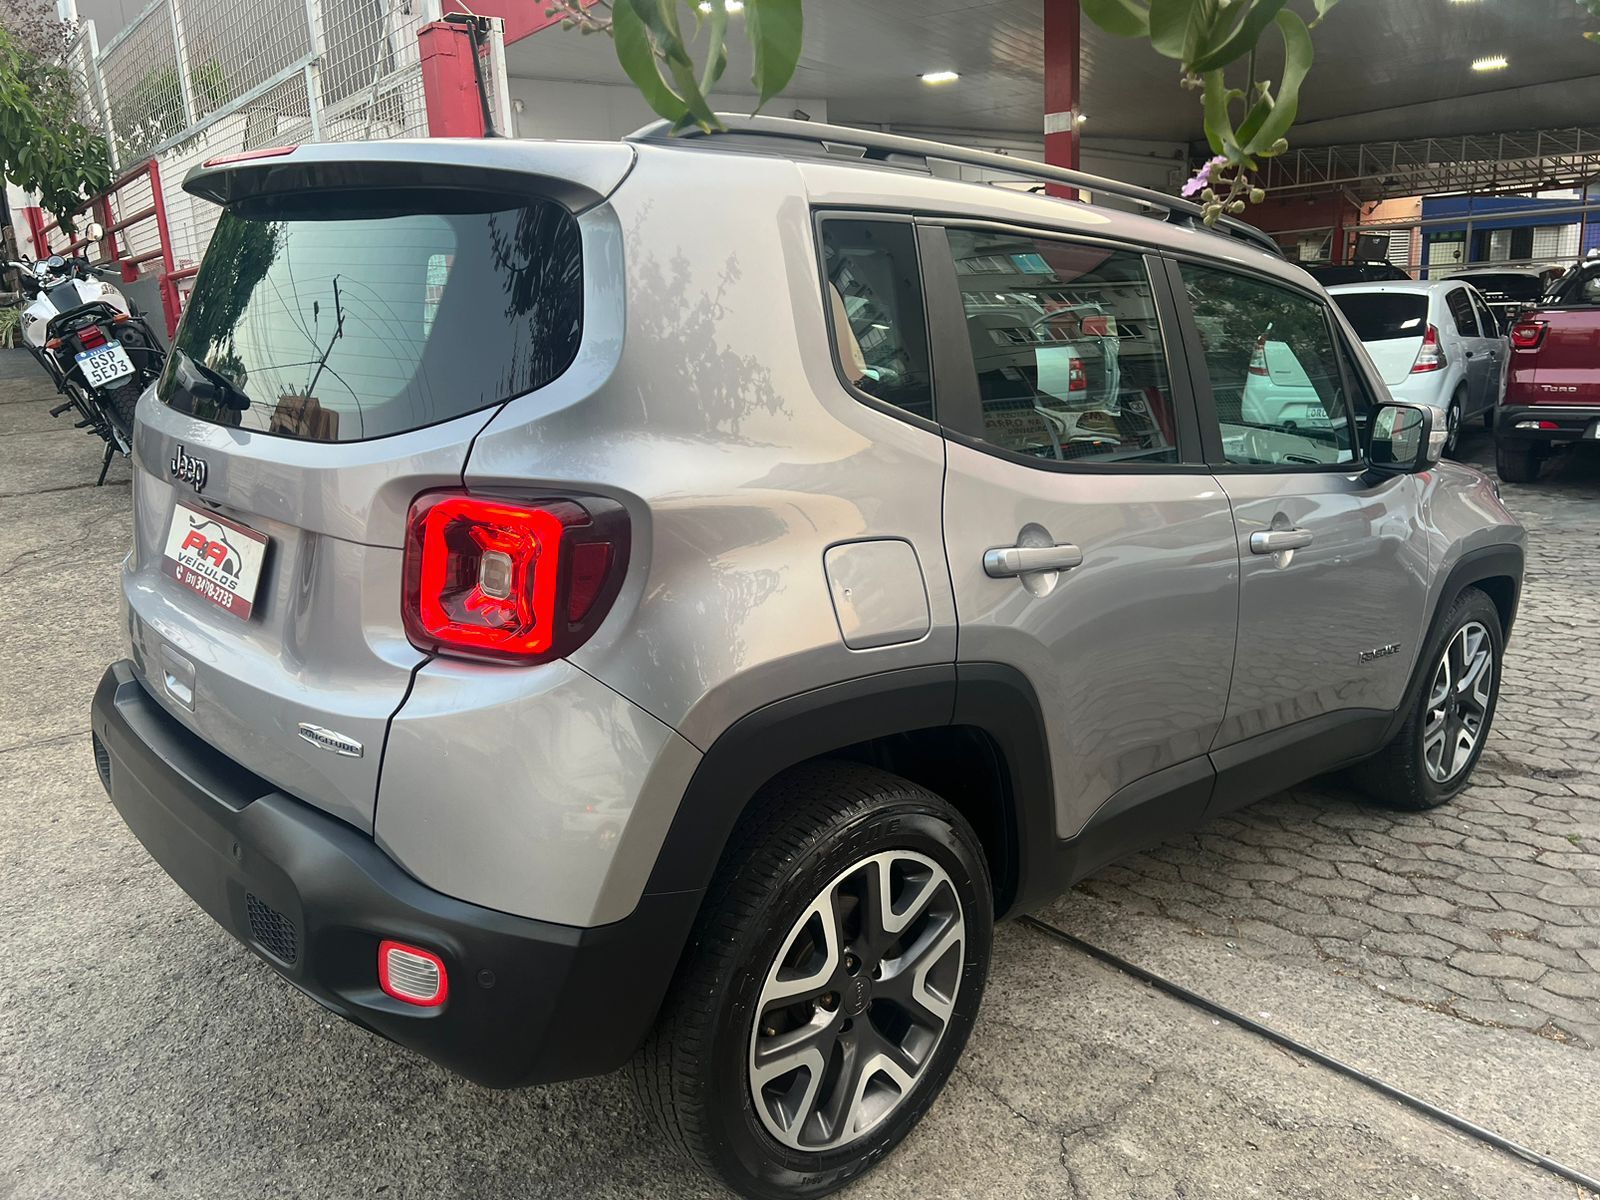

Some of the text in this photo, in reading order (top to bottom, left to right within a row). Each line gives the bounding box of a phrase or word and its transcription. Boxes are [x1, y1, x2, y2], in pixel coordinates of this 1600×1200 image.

[89, 350, 116, 369] GSP
[91, 360, 128, 382] 5E93
[170, 443, 208, 494] Jeep
[181, 529, 228, 568] P&A
[178, 552, 238, 591] VEÍCULOS
